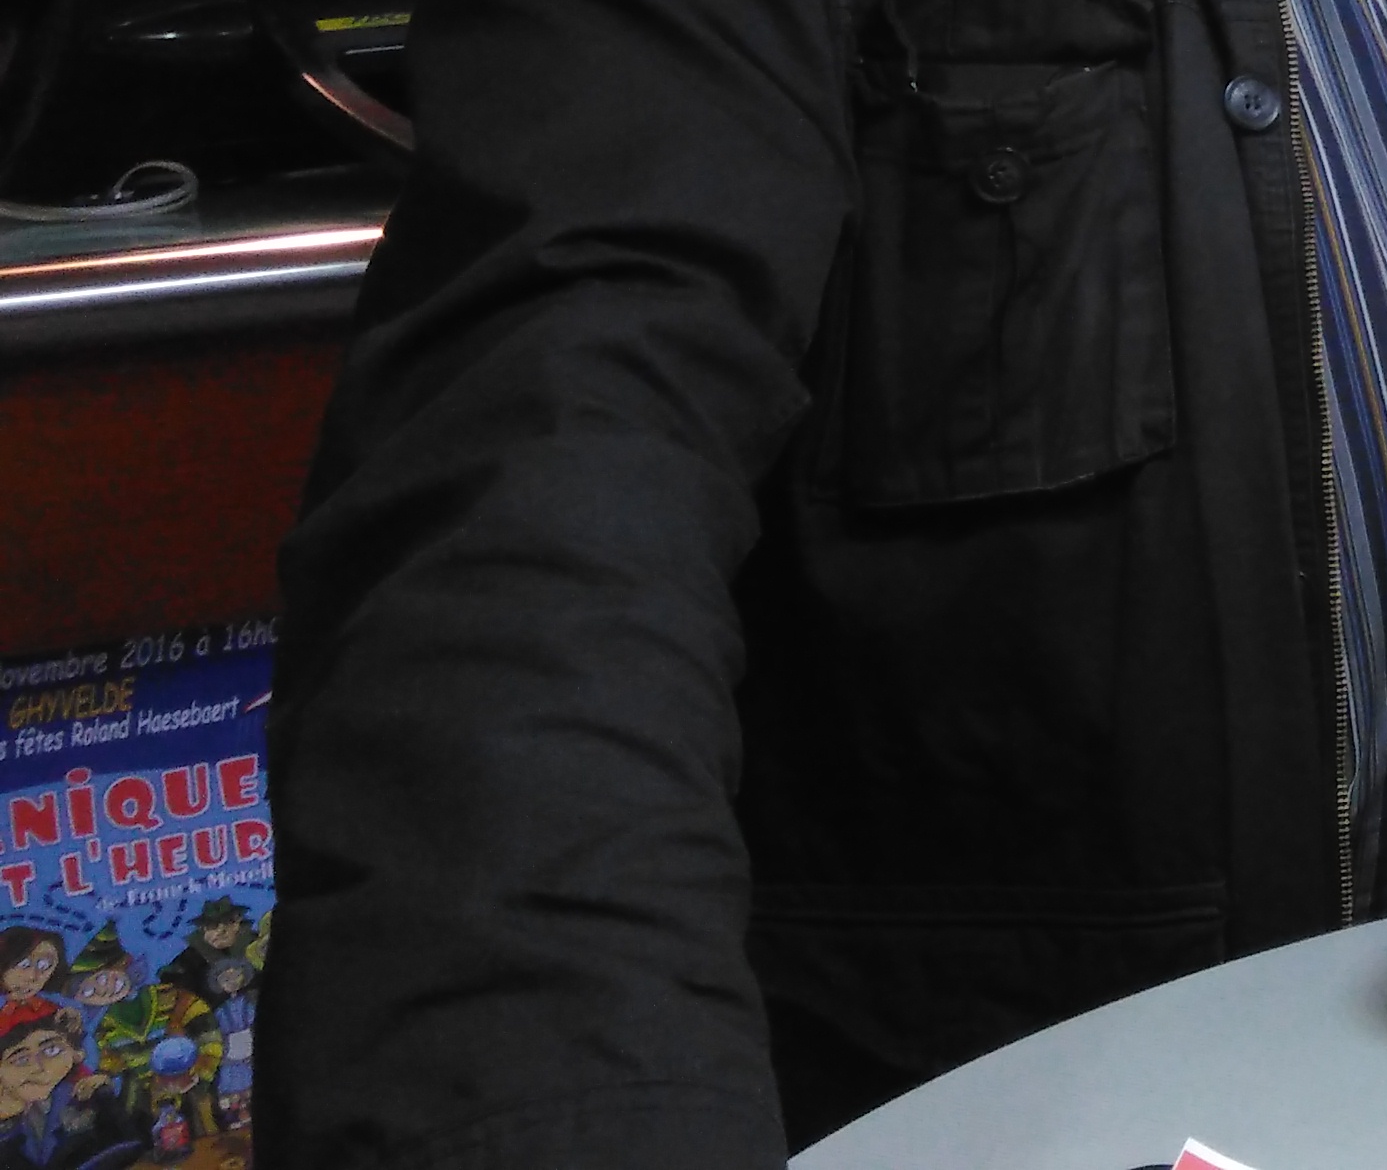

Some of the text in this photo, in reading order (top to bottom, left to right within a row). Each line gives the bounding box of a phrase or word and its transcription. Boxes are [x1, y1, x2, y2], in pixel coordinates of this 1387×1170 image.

[120, 630, 186, 670] 2016
[8, 676, 136, 729] GHYVELDE
[14, 726, 64, 759] fêtes
[70, 711, 131, 748] Roland
